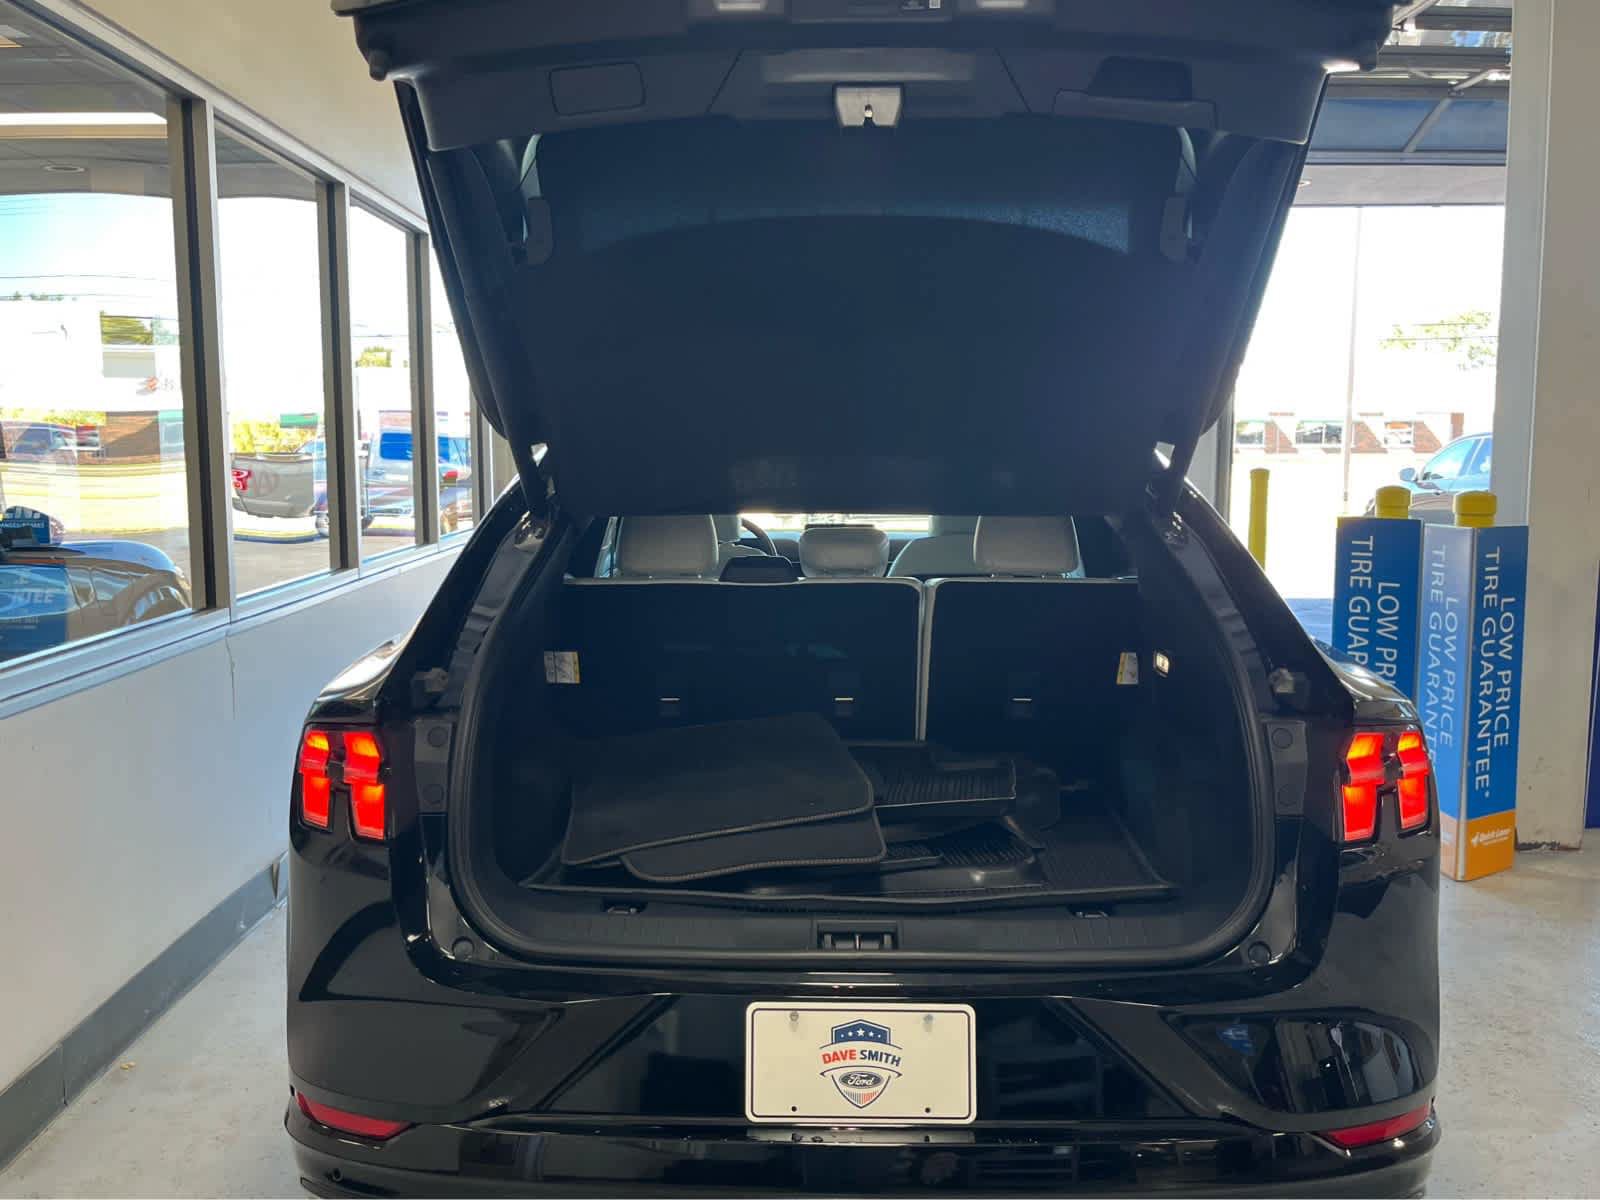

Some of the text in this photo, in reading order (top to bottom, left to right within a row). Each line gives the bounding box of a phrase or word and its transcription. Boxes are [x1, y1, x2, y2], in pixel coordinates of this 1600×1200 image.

[1350, 535, 1374, 589] TIRE
[1431, 543, 1447, 603] TIRE
[1483, 545, 1500, 609] TIRE
[1376, 581, 1401, 641] LOW
[1440, 596, 1459, 748] LOW PRICE
[1493, 597, 1516, 748] LOW PRICE
[821, 1049, 902, 1067] DAVE SMITH
[847, 1073, 875, 1087] Ford
